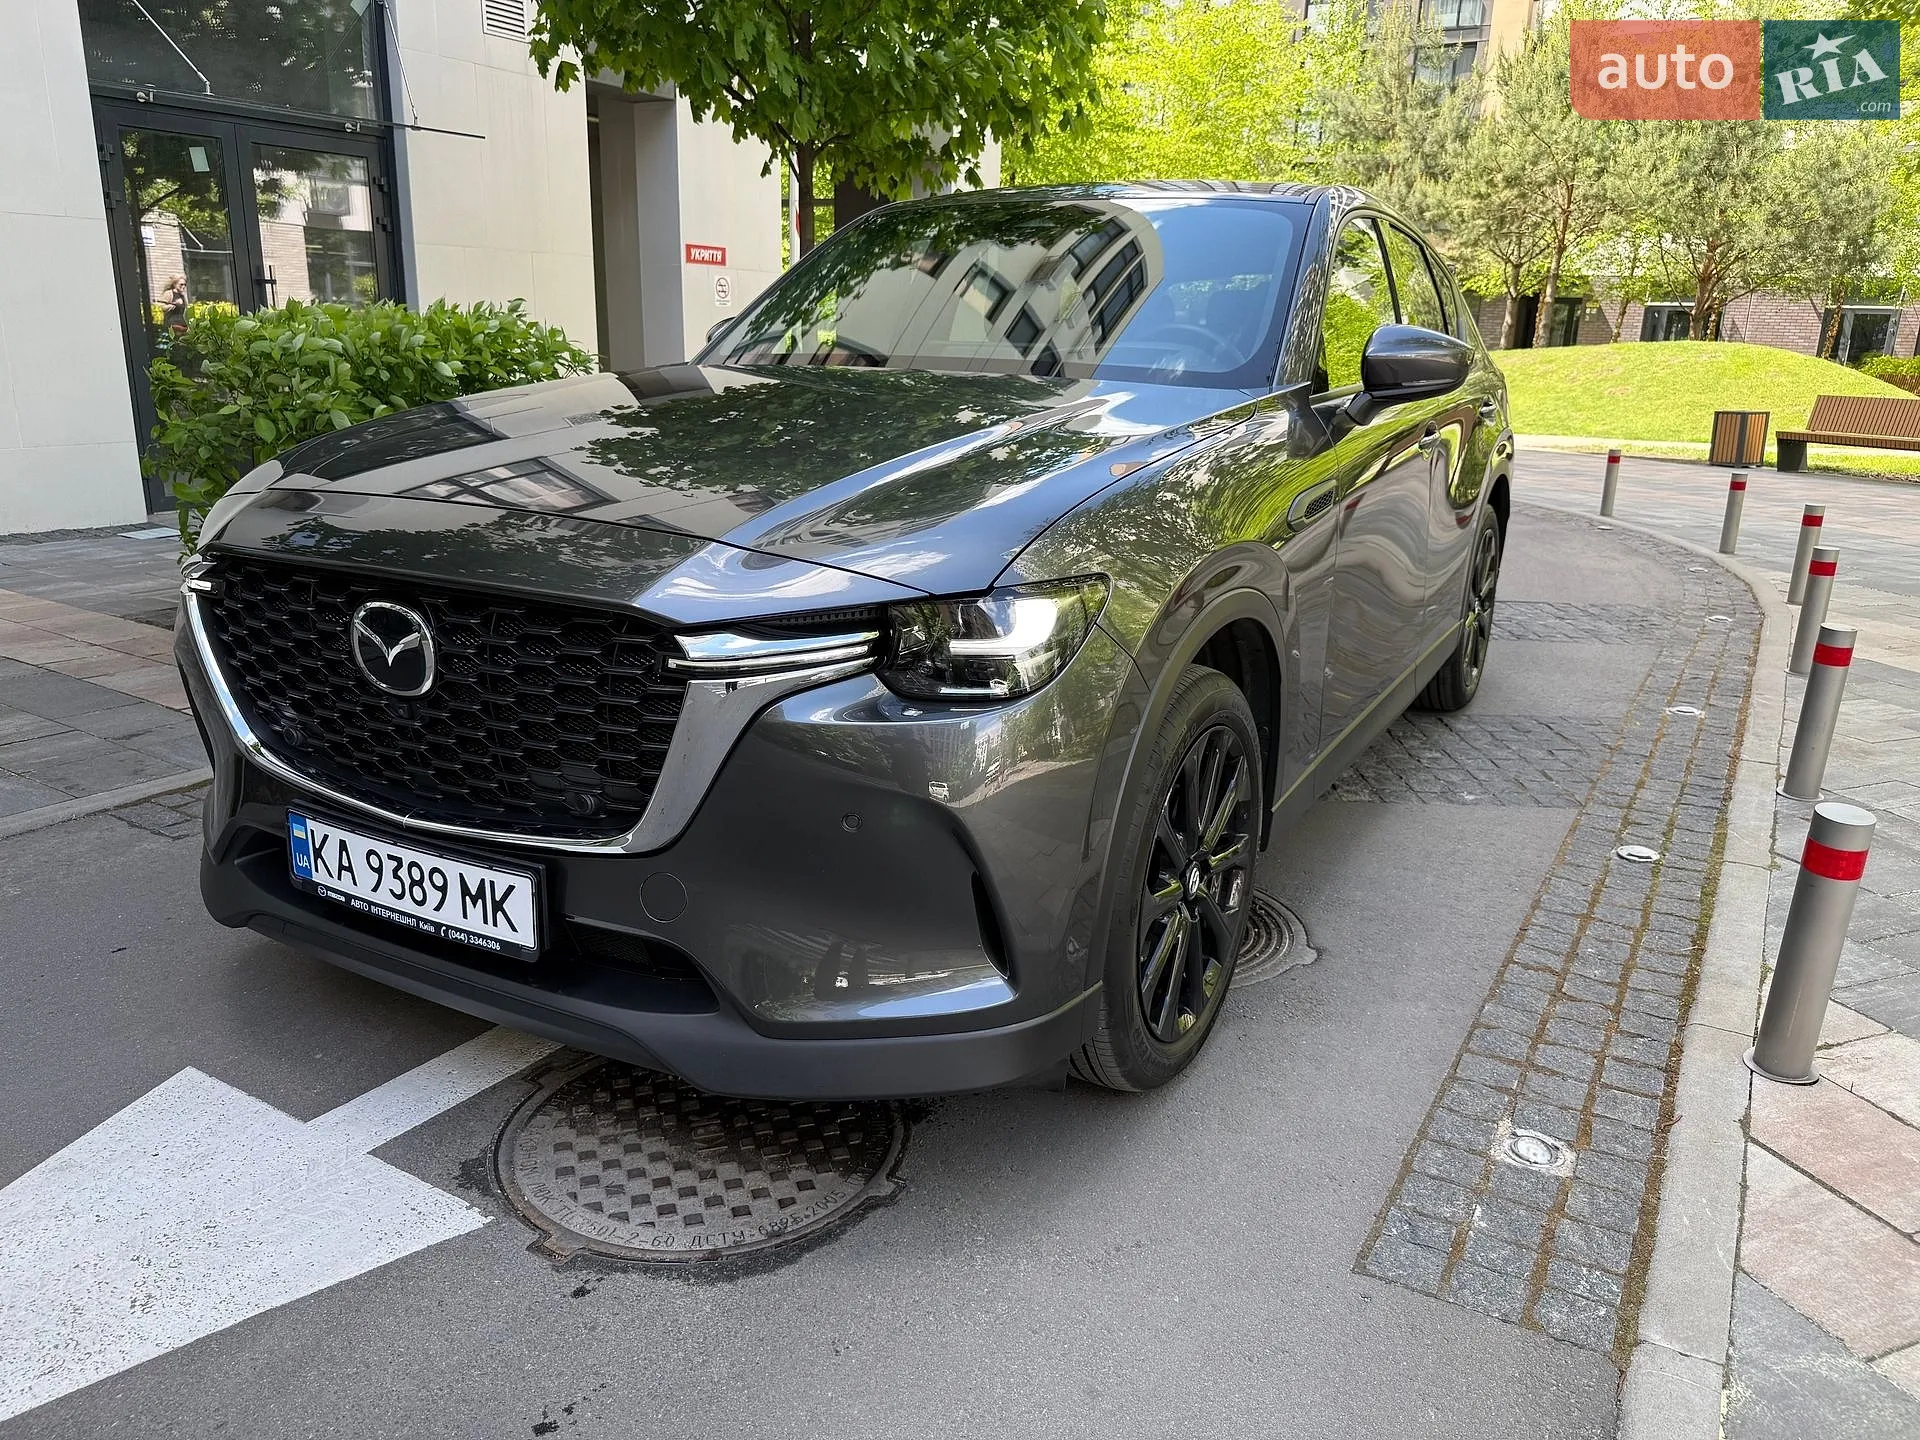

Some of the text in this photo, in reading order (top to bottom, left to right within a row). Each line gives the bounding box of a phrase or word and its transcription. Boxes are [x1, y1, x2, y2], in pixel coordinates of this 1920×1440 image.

[690, 248, 722, 262] УКРИТТЯ
[296, 852, 310, 869] UA
[309, 828, 519, 933] KA 9389 MK
[350, 898, 369, 912] АВТО
[419, 920, 435, 933] Київ
[448, 928, 468, 943] (044)
[469, 935, 501, 951] 3346306
